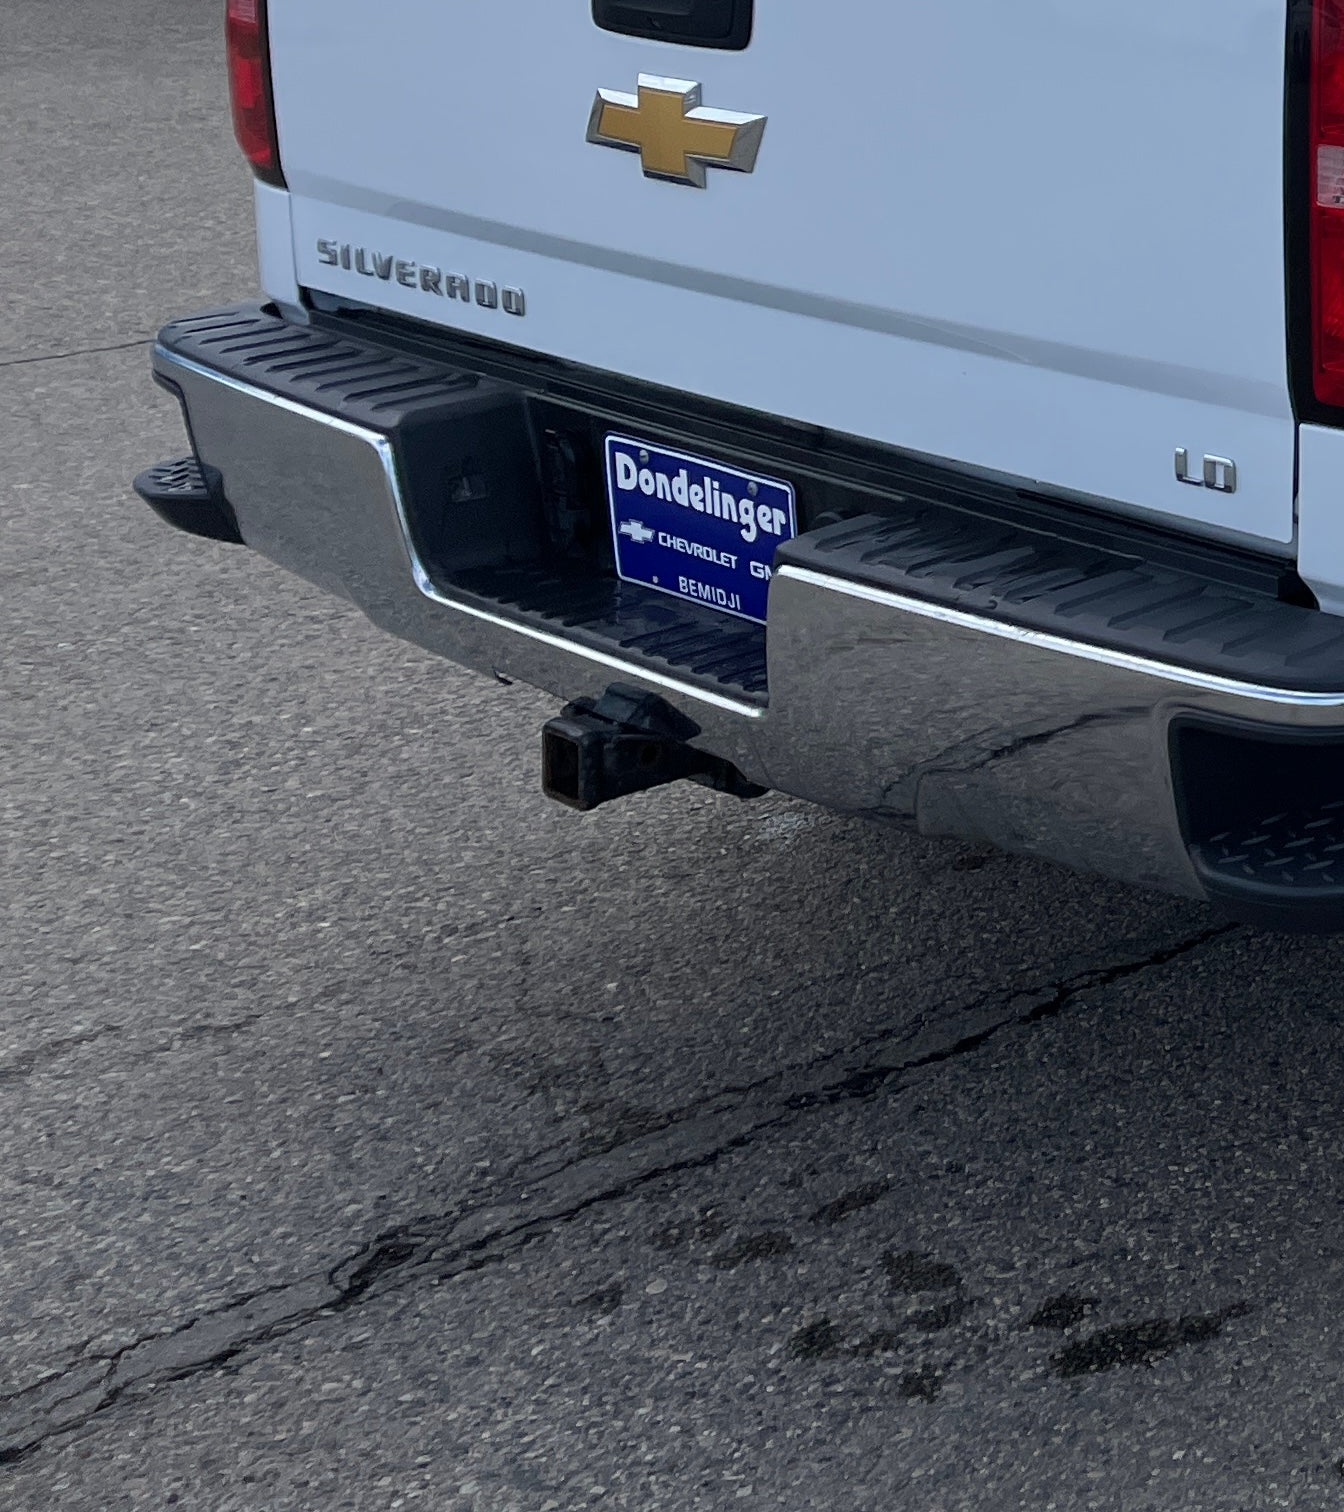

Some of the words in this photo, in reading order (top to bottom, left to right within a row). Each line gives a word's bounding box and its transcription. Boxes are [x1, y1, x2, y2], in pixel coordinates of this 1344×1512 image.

[316, 238, 525, 317] SILVERADO
[1175, 447, 1237, 494] LD
[614, 451, 787, 543] Dondelinger
[657, 531, 738, 570] CHEVROLET
[678, 575, 741, 611] BEMIDJI
